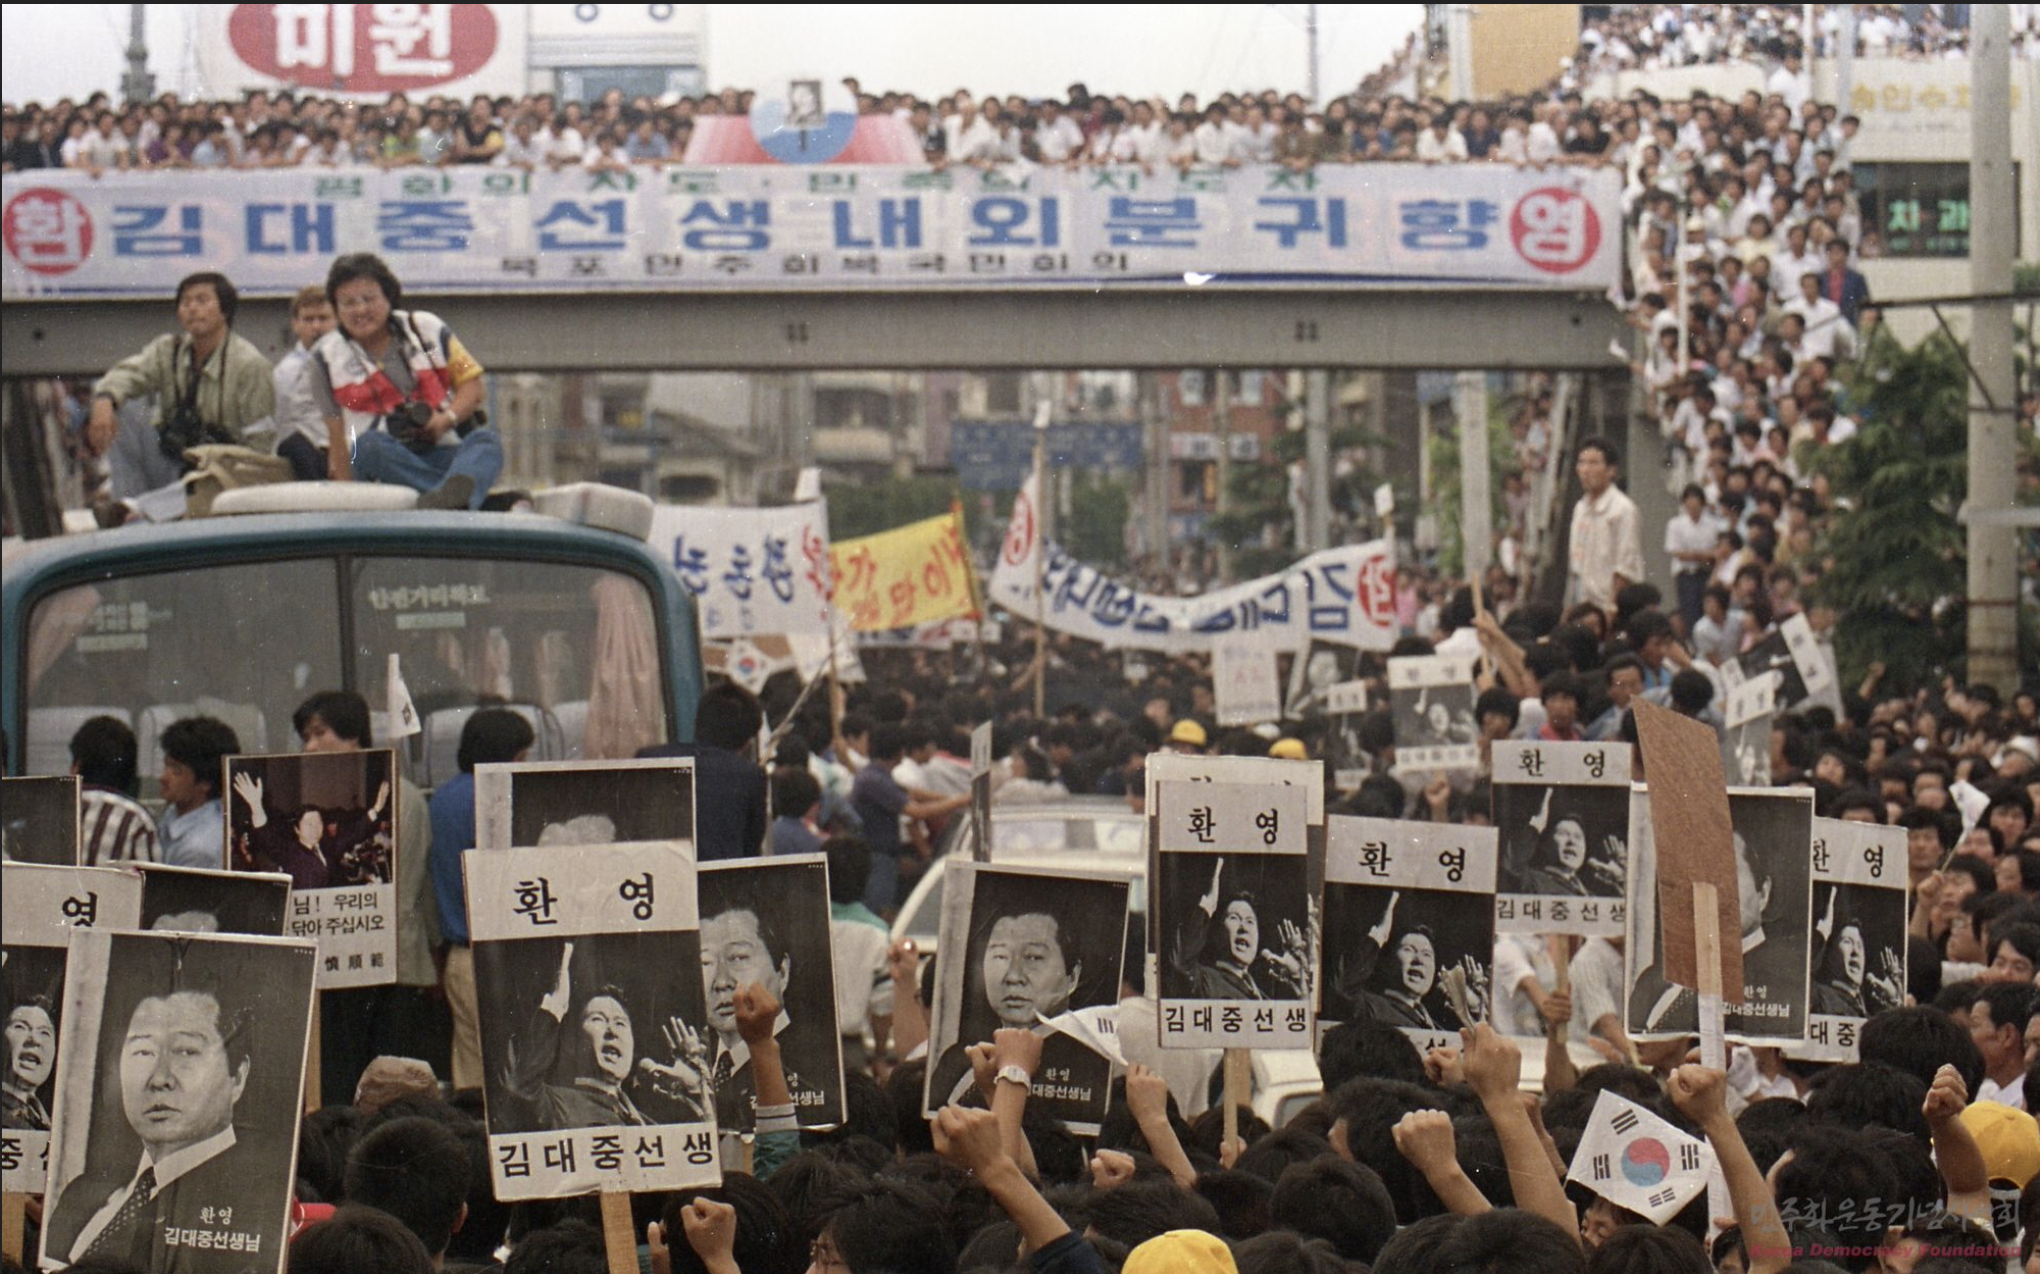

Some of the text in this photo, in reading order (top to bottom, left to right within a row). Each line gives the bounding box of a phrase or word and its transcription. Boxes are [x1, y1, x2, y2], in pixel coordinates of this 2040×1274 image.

[275, 3, 453, 76] 미원
[113, 197, 1500, 256] 김대중선생내외분귀향
[1520, 194, 1585, 261] 영
[1519, 749, 1604, 778] 환영
[1188, 806, 1278, 844] 환영
[1358, 841, 1465, 882] 환영
[62, 891, 98, 928] 영
[294, 892, 377, 916] 님! 우리의
[513, 872, 654, 925] 환영
[326, 915, 385, 935] 주십시오
[1165, 1005, 1307, 1033] 김대중선생
[1810, 1021, 1856, 1047] 대중
[787, 1072, 798, 1087] 영
[1045, 1067, 1070, 1082] 환영
[2, 1138, 50, 1171] 중
[500, 1131, 714, 1178] 김대중선생
[200, 1206, 234, 1226] 환영
[163, 1227, 262, 1253] 김대중선생님
